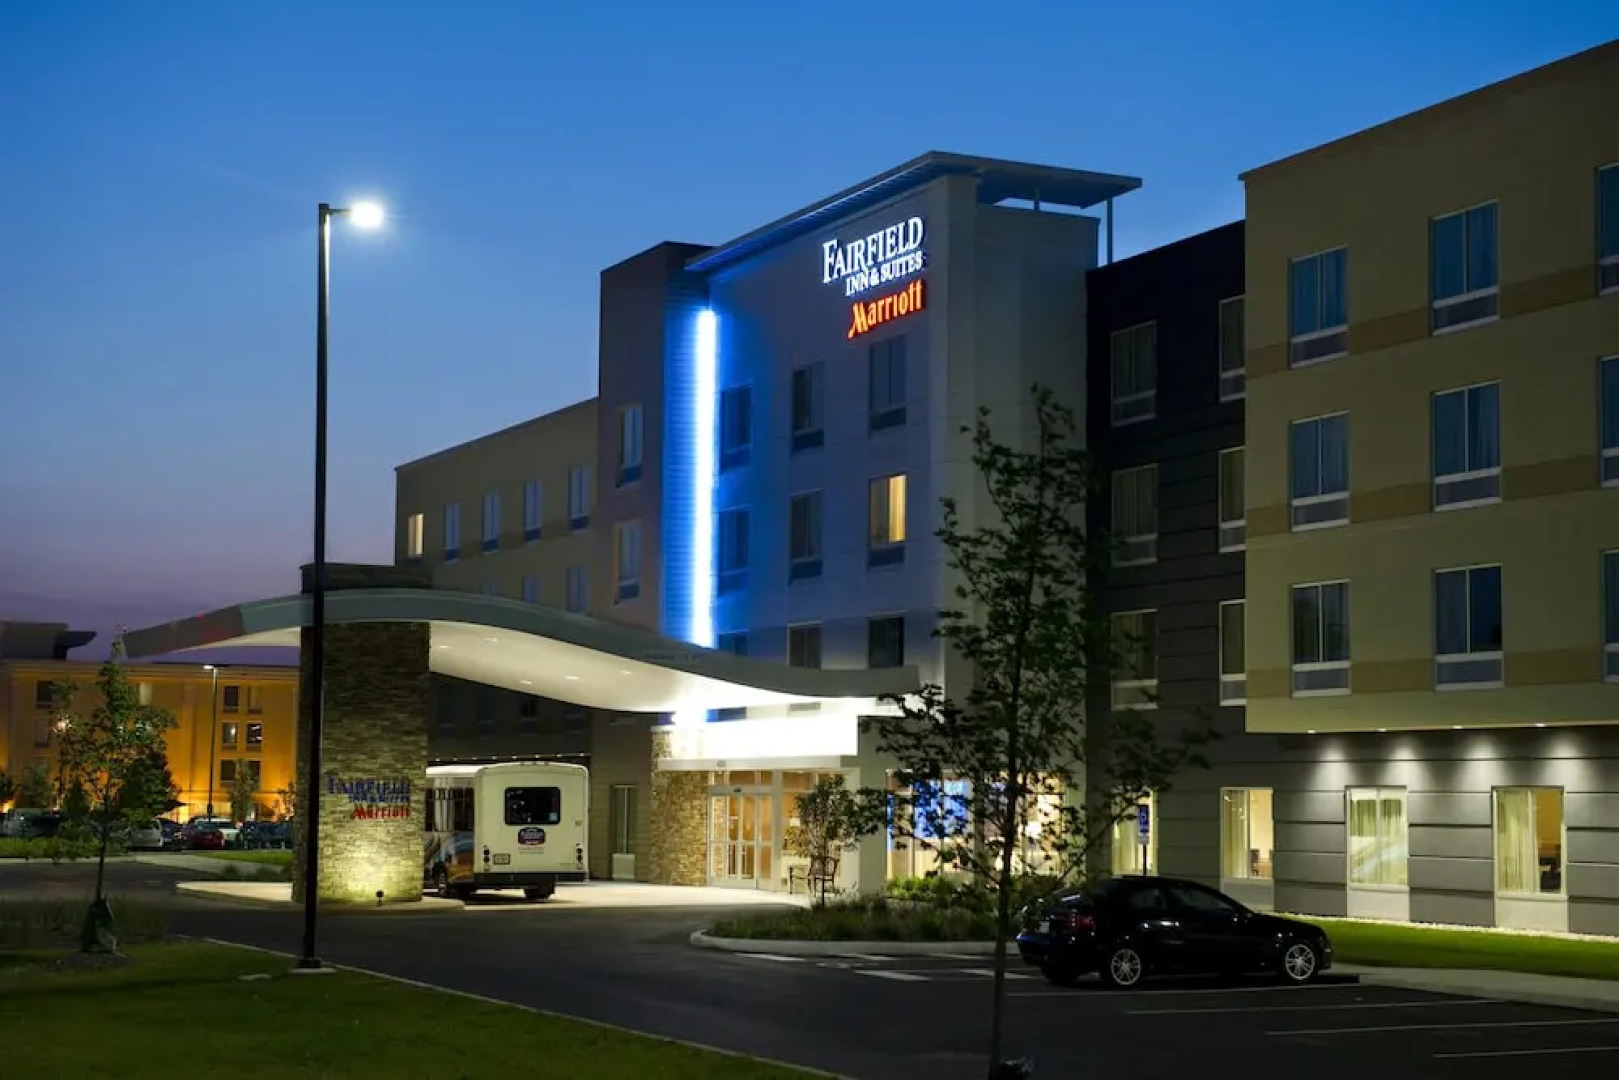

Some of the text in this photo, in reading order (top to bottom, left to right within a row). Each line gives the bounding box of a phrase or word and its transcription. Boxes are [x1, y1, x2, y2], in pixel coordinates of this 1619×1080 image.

[822, 216, 924, 284] FAIRFIELD
[880, 250, 923, 283] SUITES
[847, 278, 923, 339] Marriott
